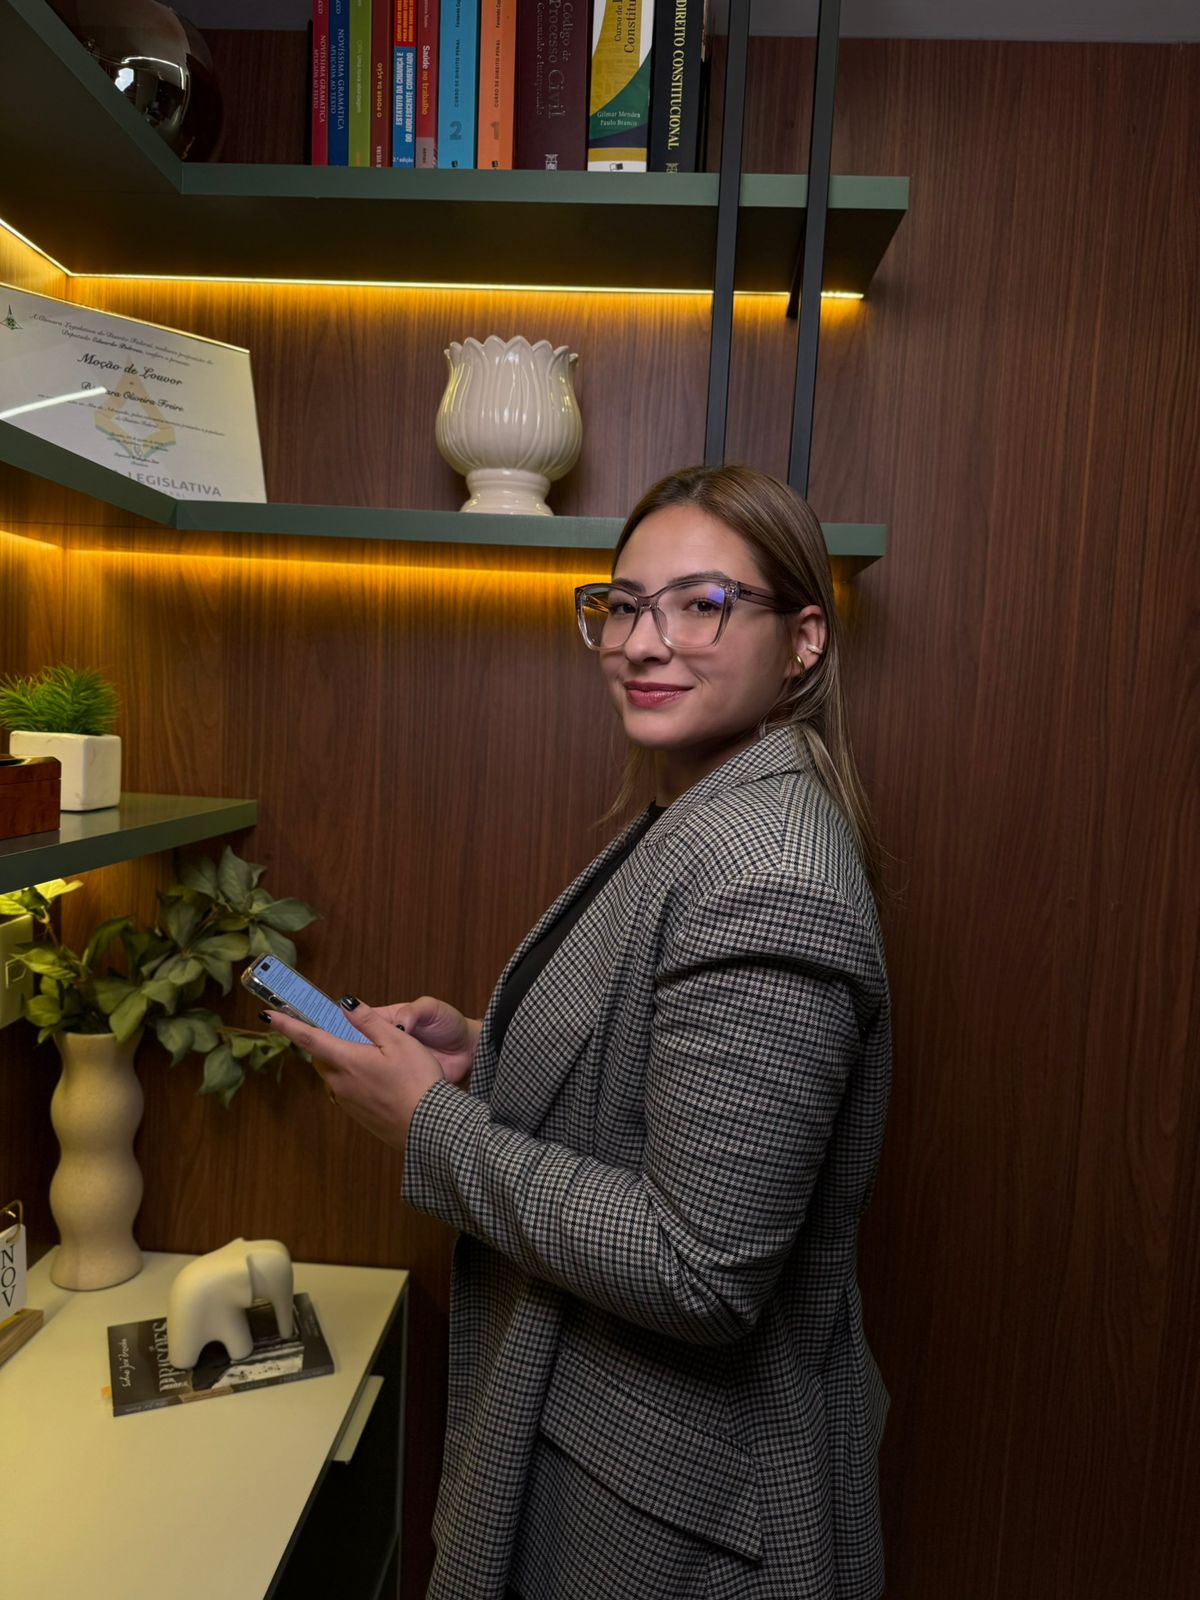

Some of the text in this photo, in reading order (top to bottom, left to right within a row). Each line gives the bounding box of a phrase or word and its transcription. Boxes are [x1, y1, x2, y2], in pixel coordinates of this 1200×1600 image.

[616, 5, 622, 15] de
[536, 2, 545, 52] Comentado
[560, 2, 573, 61] Código de
[614, 17, 622, 42] Curso
[422, 45, 430, 69] Saúde
[548, 0, 566, 119] Processo Civil
[396, 58, 404, 84] CRIANÇA
[406, 53, 414, 90] COMENTADO
[422, 71, 428, 82] no
[667, 0, 687, 150] DIREITO CONSTITUCIONAL
[331, 80, 336, 91] AO
[377, 80, 382, 89] DA
[396, 85, 403, 94] DA
[337, 79, 345, 130] GRAMÁTICA
[395, 95, 403, 125] ESTATUTO
[405, 134, 412, 142] DO
[450, 121, 462, 140] 2
[491, 121, 500, 140] 1
[77, 353, 183, 386] Moção de Louvor
[123, 390, 155, 406] Oliveira
[157, 399, 184, 412] Freire
[2, 1244, 16, 1307] NOV
